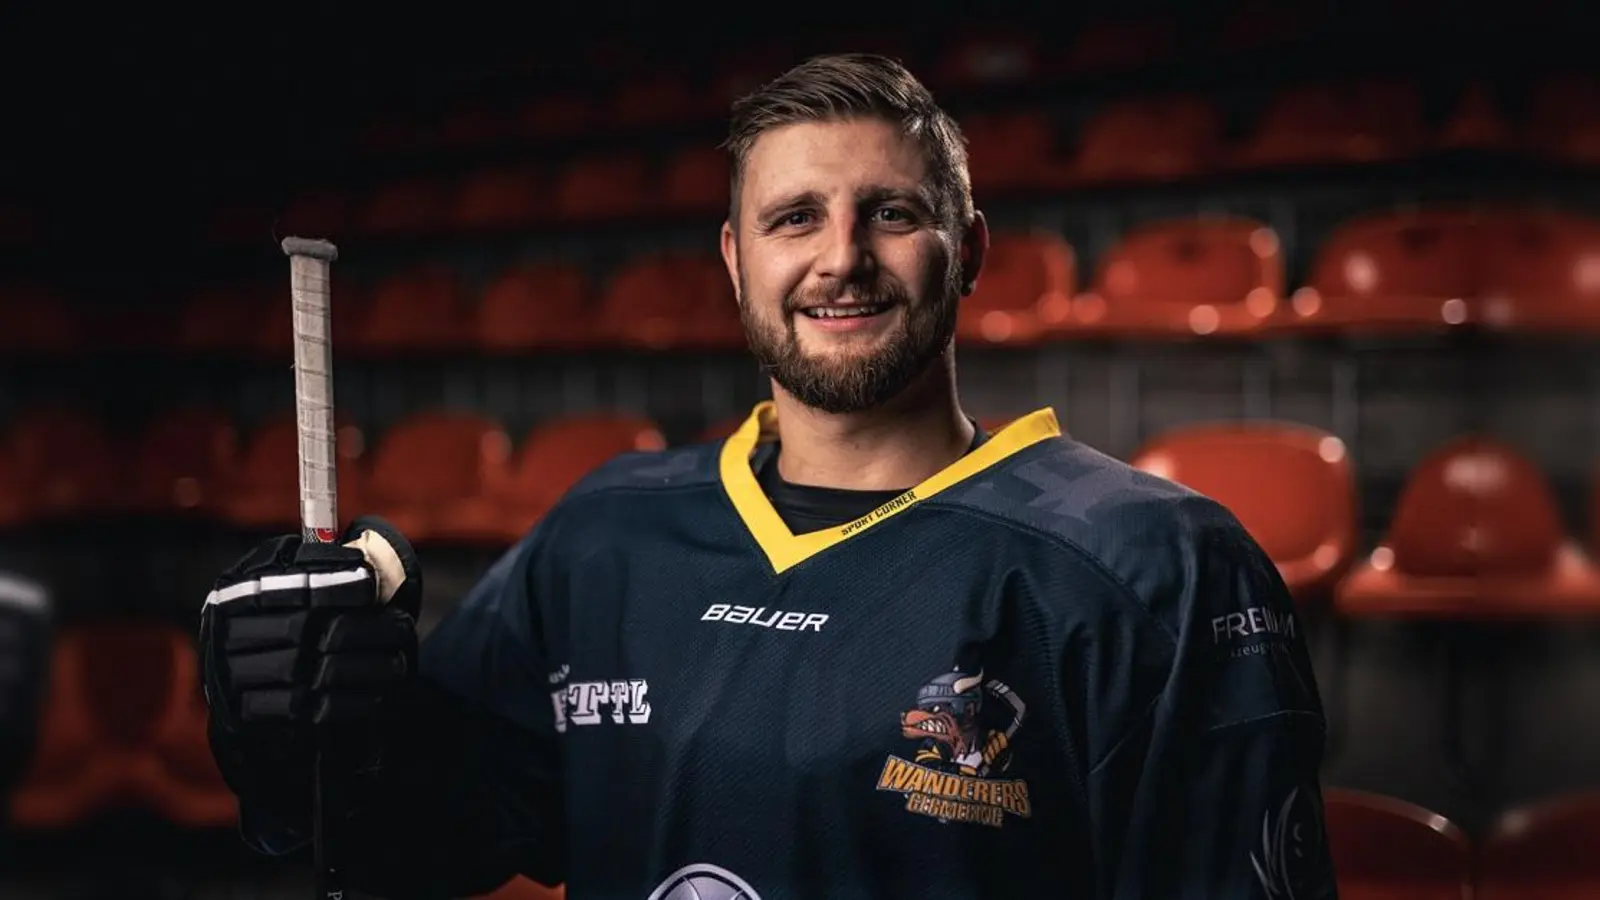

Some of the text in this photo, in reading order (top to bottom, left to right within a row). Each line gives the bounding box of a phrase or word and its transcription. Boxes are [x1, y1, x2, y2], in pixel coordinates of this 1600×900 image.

[841, 490, 917, 536] SPORT CORNER
[701, 603, 829, 632] BAUER
[877, 755, 1031, 817] WANDERERS
